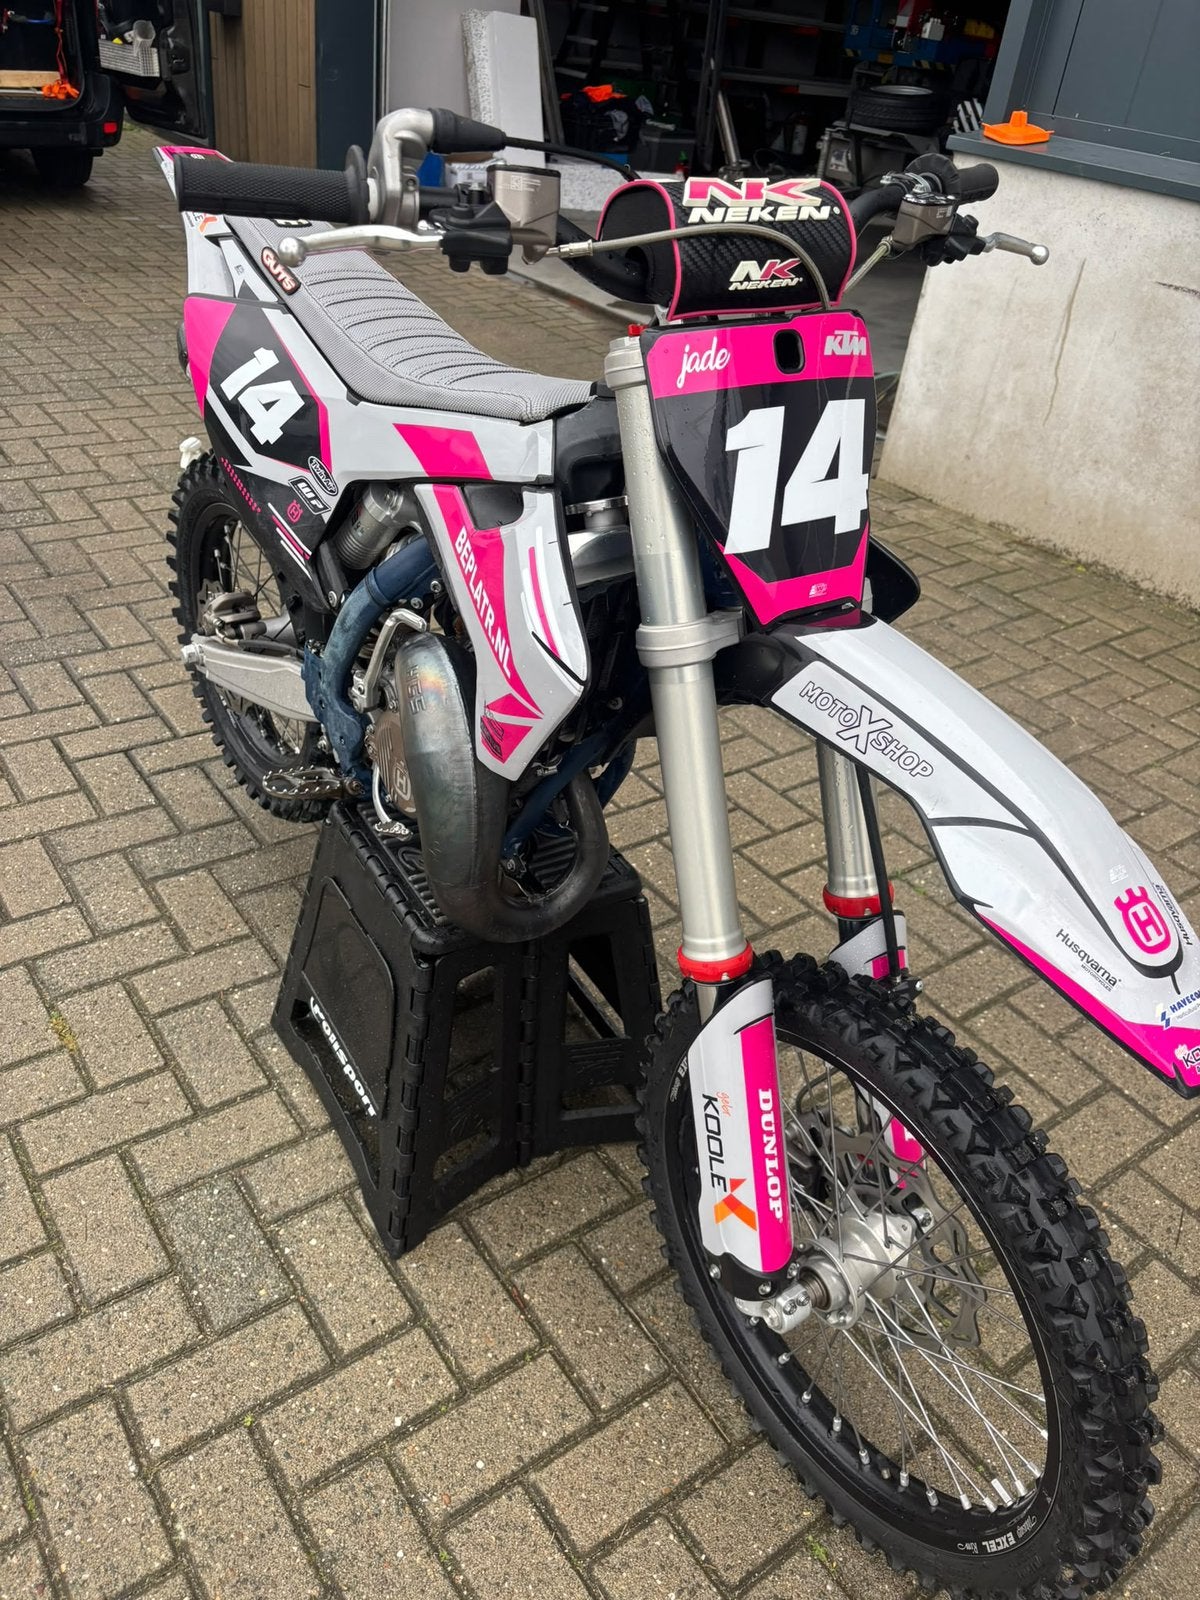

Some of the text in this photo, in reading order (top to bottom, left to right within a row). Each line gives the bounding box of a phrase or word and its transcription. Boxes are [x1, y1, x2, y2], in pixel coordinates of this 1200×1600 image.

[682, 177, 822, 207] NK
[688, 206, 832, 224] NEKEN
[262, 248, 296, 292] GUTS
[728, 278, 799, 291] NEKEN
[729, 257, 802, 282] NK
[676, 336, 731, 389] jade
[824, 330, 867, 356] KTM
[220, 347, 305, 445] 14
[722, 398, 869, 555] 14
[455, 526, 511, 679] BEPLATR.NL
[1056, 928, 1118, 987] Husqvarna
[702, 1093, 727, 1193] KOOLE
[758, 1088, 783, 1221] DUNLOP
[982, 1532, 1016, 1553] EXCEL
